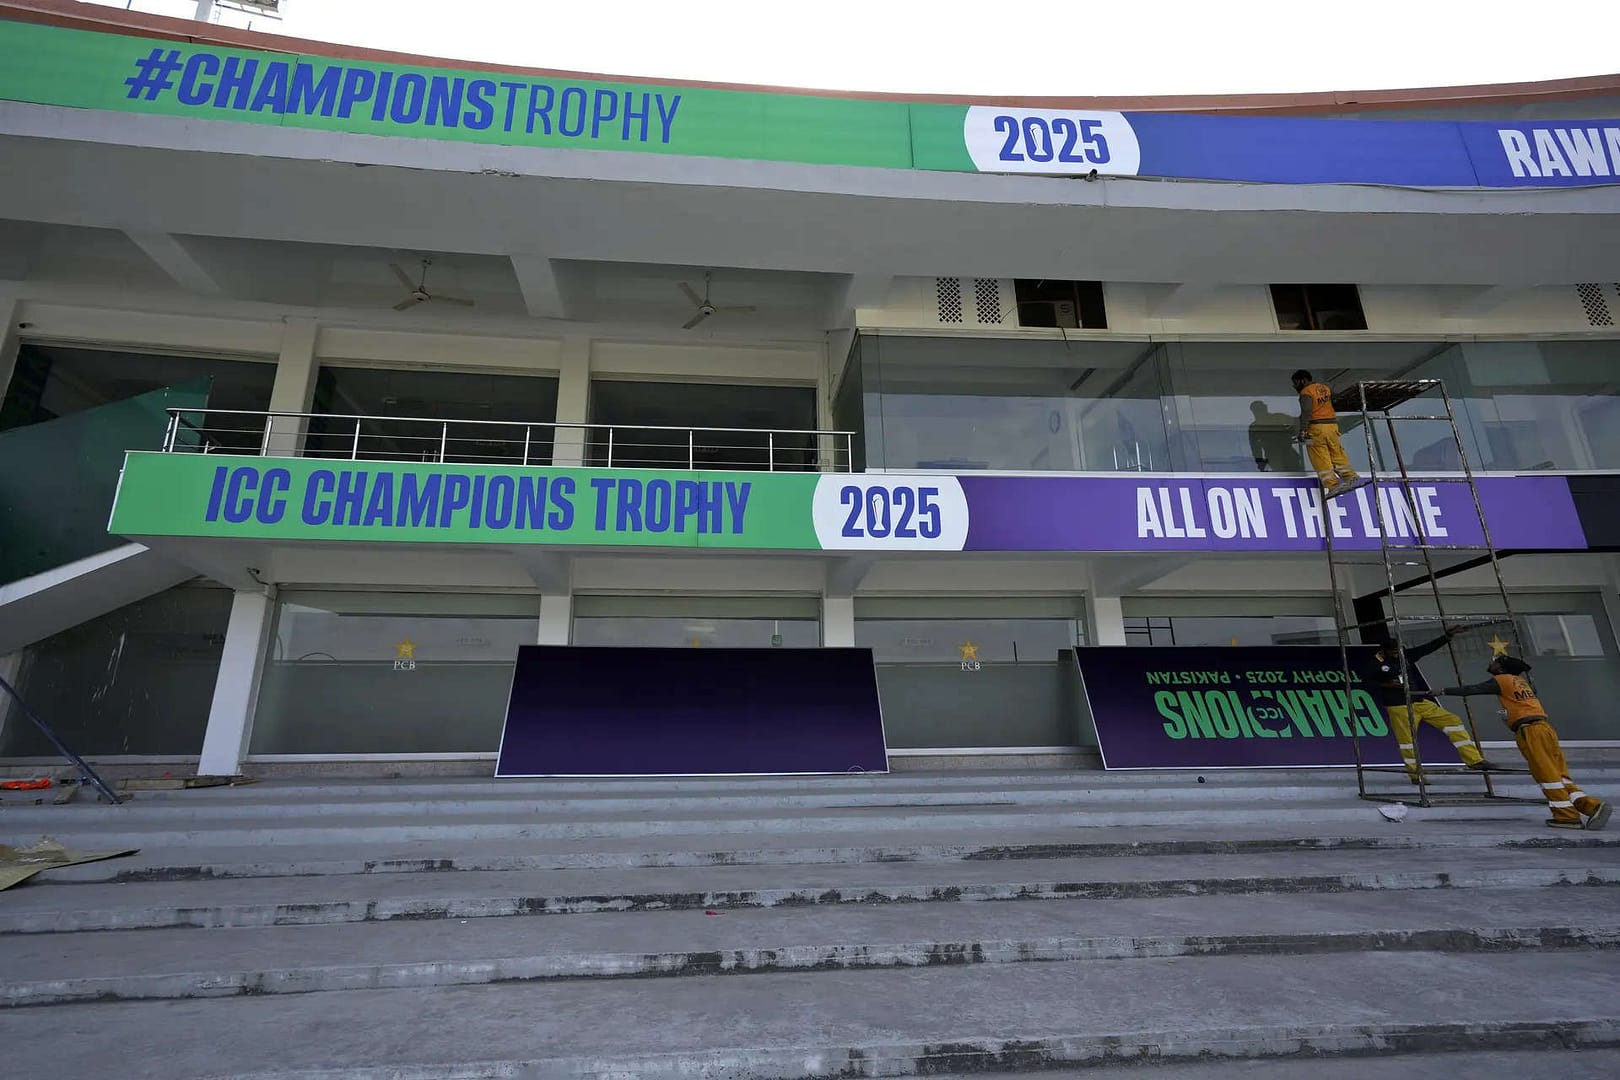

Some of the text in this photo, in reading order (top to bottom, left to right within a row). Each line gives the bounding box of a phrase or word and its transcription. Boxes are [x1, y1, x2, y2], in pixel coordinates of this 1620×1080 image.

[125, 48, 681, 143] #CHAMPIONSTROPHY
[994, 115, 1110, 164] 2025
[206, 467, 751, 534] ICC CHAMPIONS TROPHY
[840, 485, 942, 539] 2025
[1136, 487, 1448, 538] ALL ON THE LINE
[393, 660, 416, 670] PCB
[961, 661, 981, 671] PCB
[1146, 671, 1231, 684] PAKISTAN
[1245, 671, 1288, 684] 2025
[1255, 707, 1285, 720] ICC
